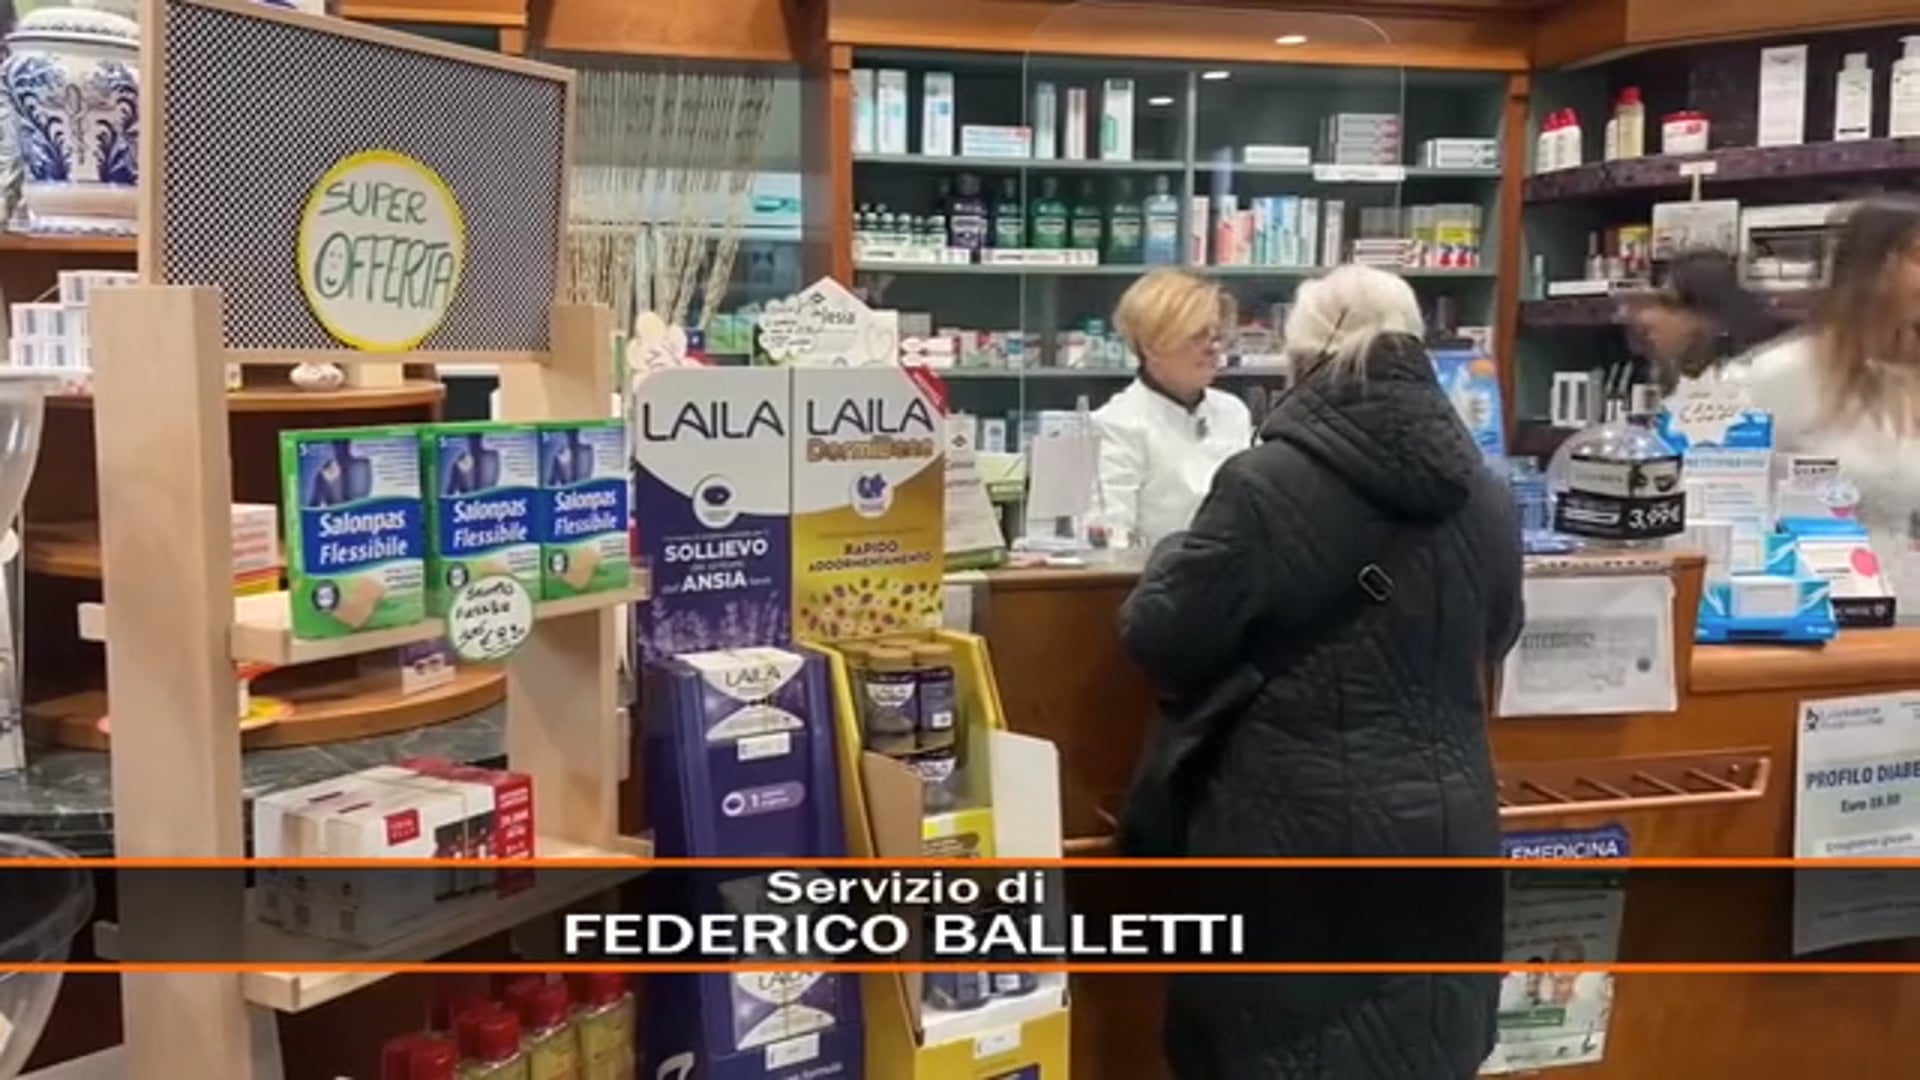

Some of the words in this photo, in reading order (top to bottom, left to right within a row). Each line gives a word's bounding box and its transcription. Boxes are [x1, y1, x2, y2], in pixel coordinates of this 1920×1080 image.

[319, 181, 428, 225] SUPER
[314, 231, 455, 310] OFFERTA
[643, 400, 784, 441] LAILA
[807, 398, 934, 434] LAILA
[453, 498, 528, 524] Salonpas
[555, 490, 616, 512] Salonpas
[318, 509, 406, 538] Salonpas
[555, 512, 617, 536] Flessibile
[453, 524, 528, 549] Flessibile
[844, 539, 899, 556] RAPIDO
[319, 537, 408, 565] Flessibile
[664, 538, 769, 562] SOLLIEVO
[681, 569, 748, 592] ANSIA
[725, 667, 781, 686] LAILA
[1806, 767, 1873, 789] PROFILO
[1841, 799, 1867, 814] Euro
